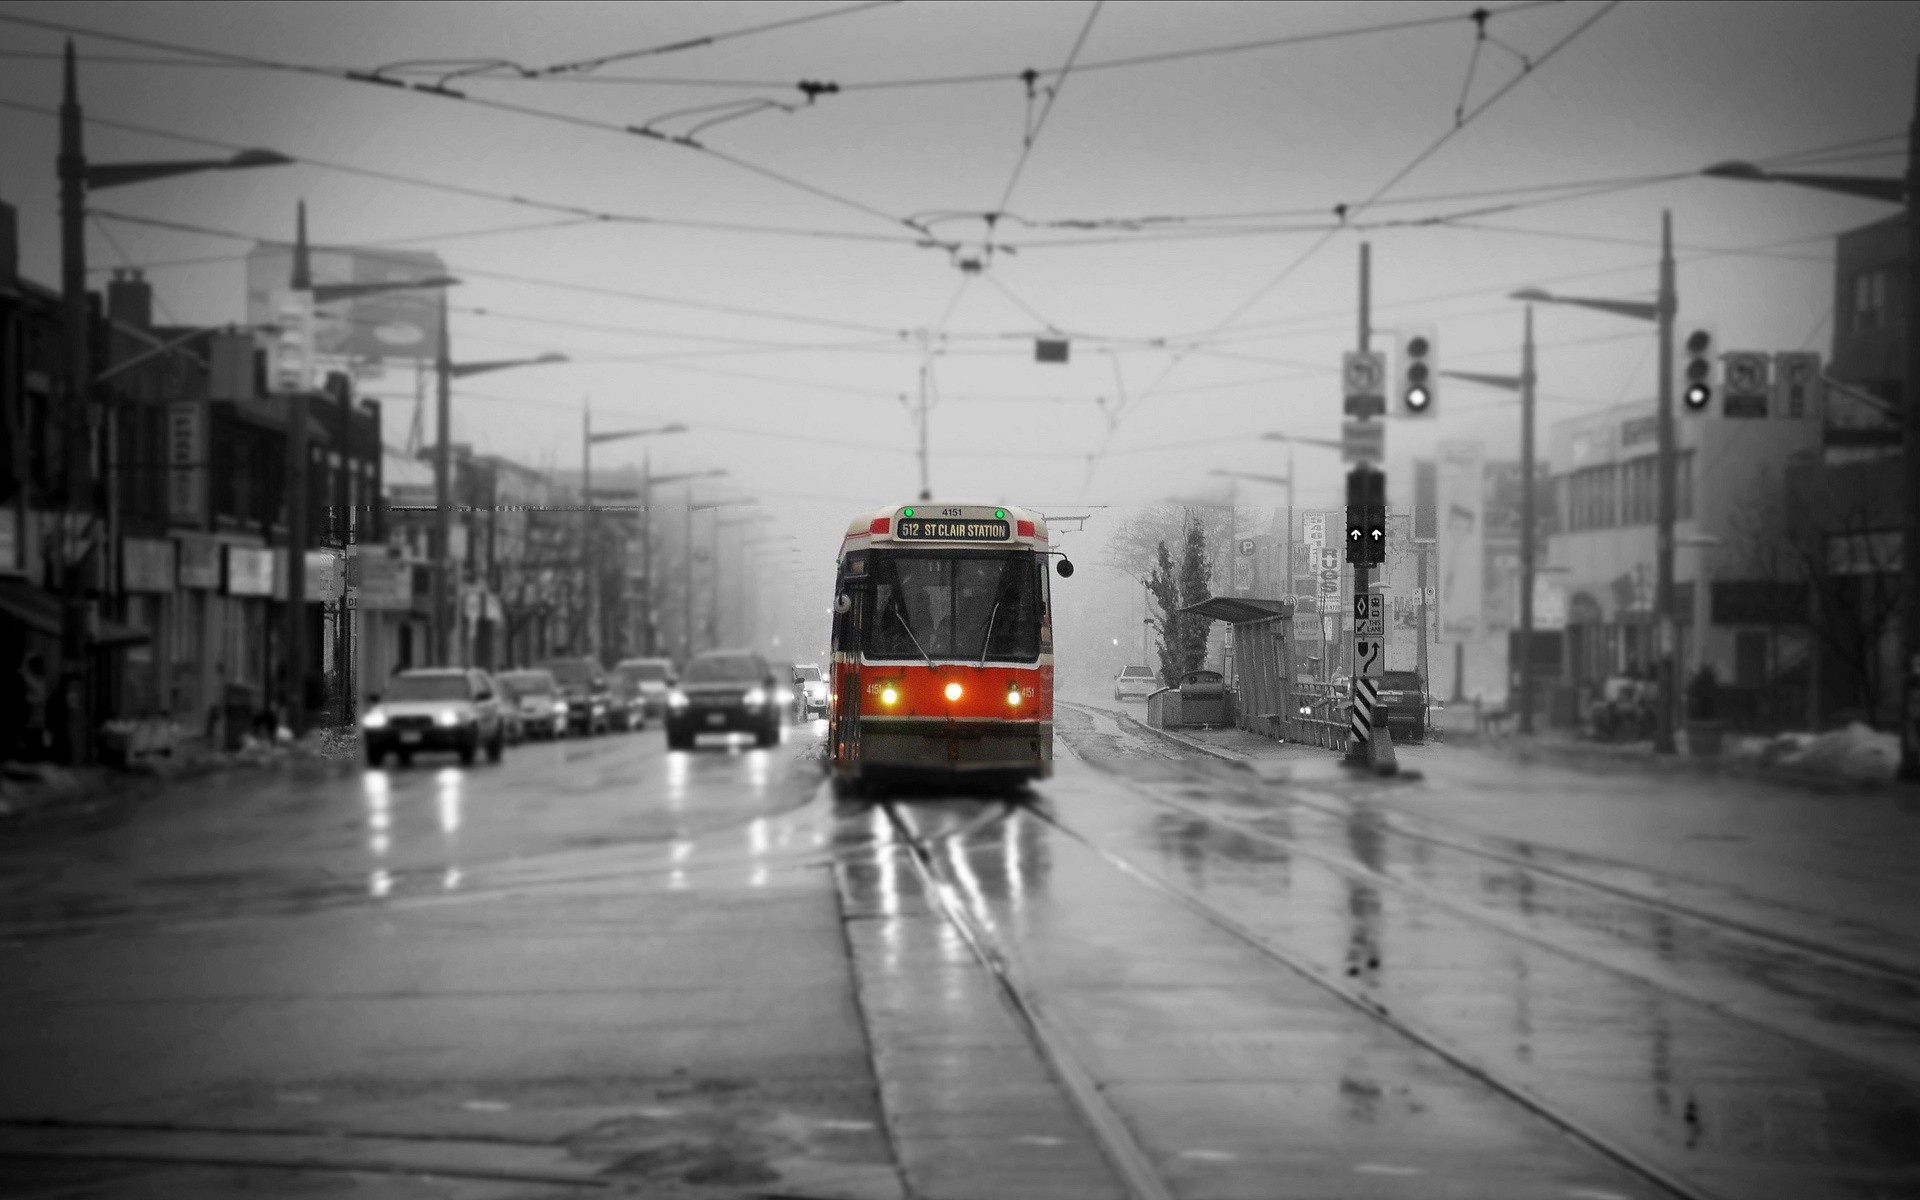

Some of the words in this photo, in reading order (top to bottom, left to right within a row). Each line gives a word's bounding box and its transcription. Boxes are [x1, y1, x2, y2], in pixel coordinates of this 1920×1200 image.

[942, 508, 962, 517] 4151
[902, 523, 919, 537] 512
[924, 524, 936, 537] ST
[938, 524, 966, 537] CLAIR
[967, 524, 1006, 538] STATION
[866, 683, 882, 695] 4151
[1021, 687, 1035, 698] 4151
